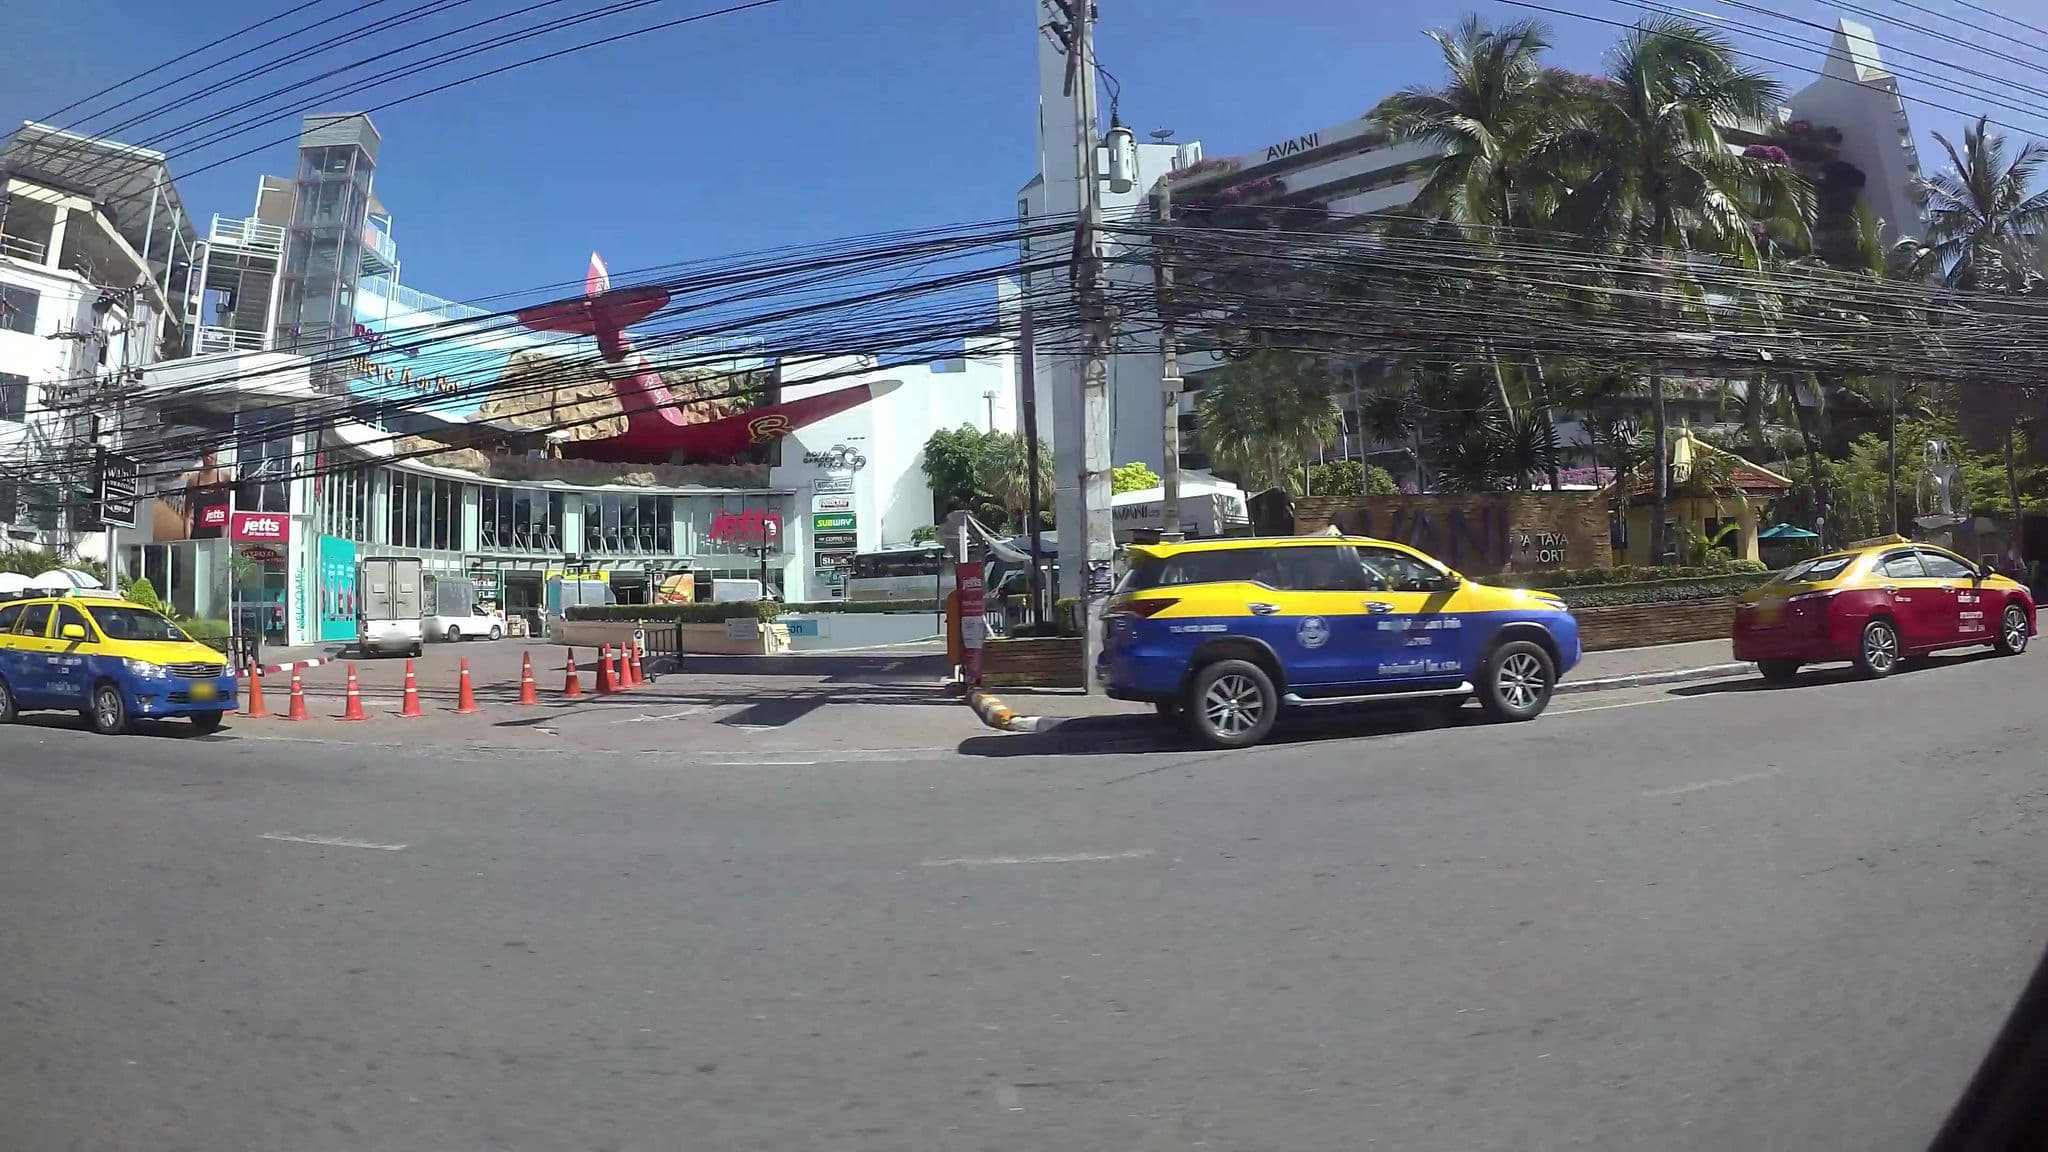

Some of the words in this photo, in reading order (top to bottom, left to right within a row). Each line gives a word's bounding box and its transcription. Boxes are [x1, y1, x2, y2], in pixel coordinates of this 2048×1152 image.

[1266, 132, 1319, 161] AVANI
[205, 509, 225, 522] jetts
[241, 517, 280, 534] jetts
[816, 518, 853, 528] SUBWAY
[1519, 533, 1569, 547] PATAYA
